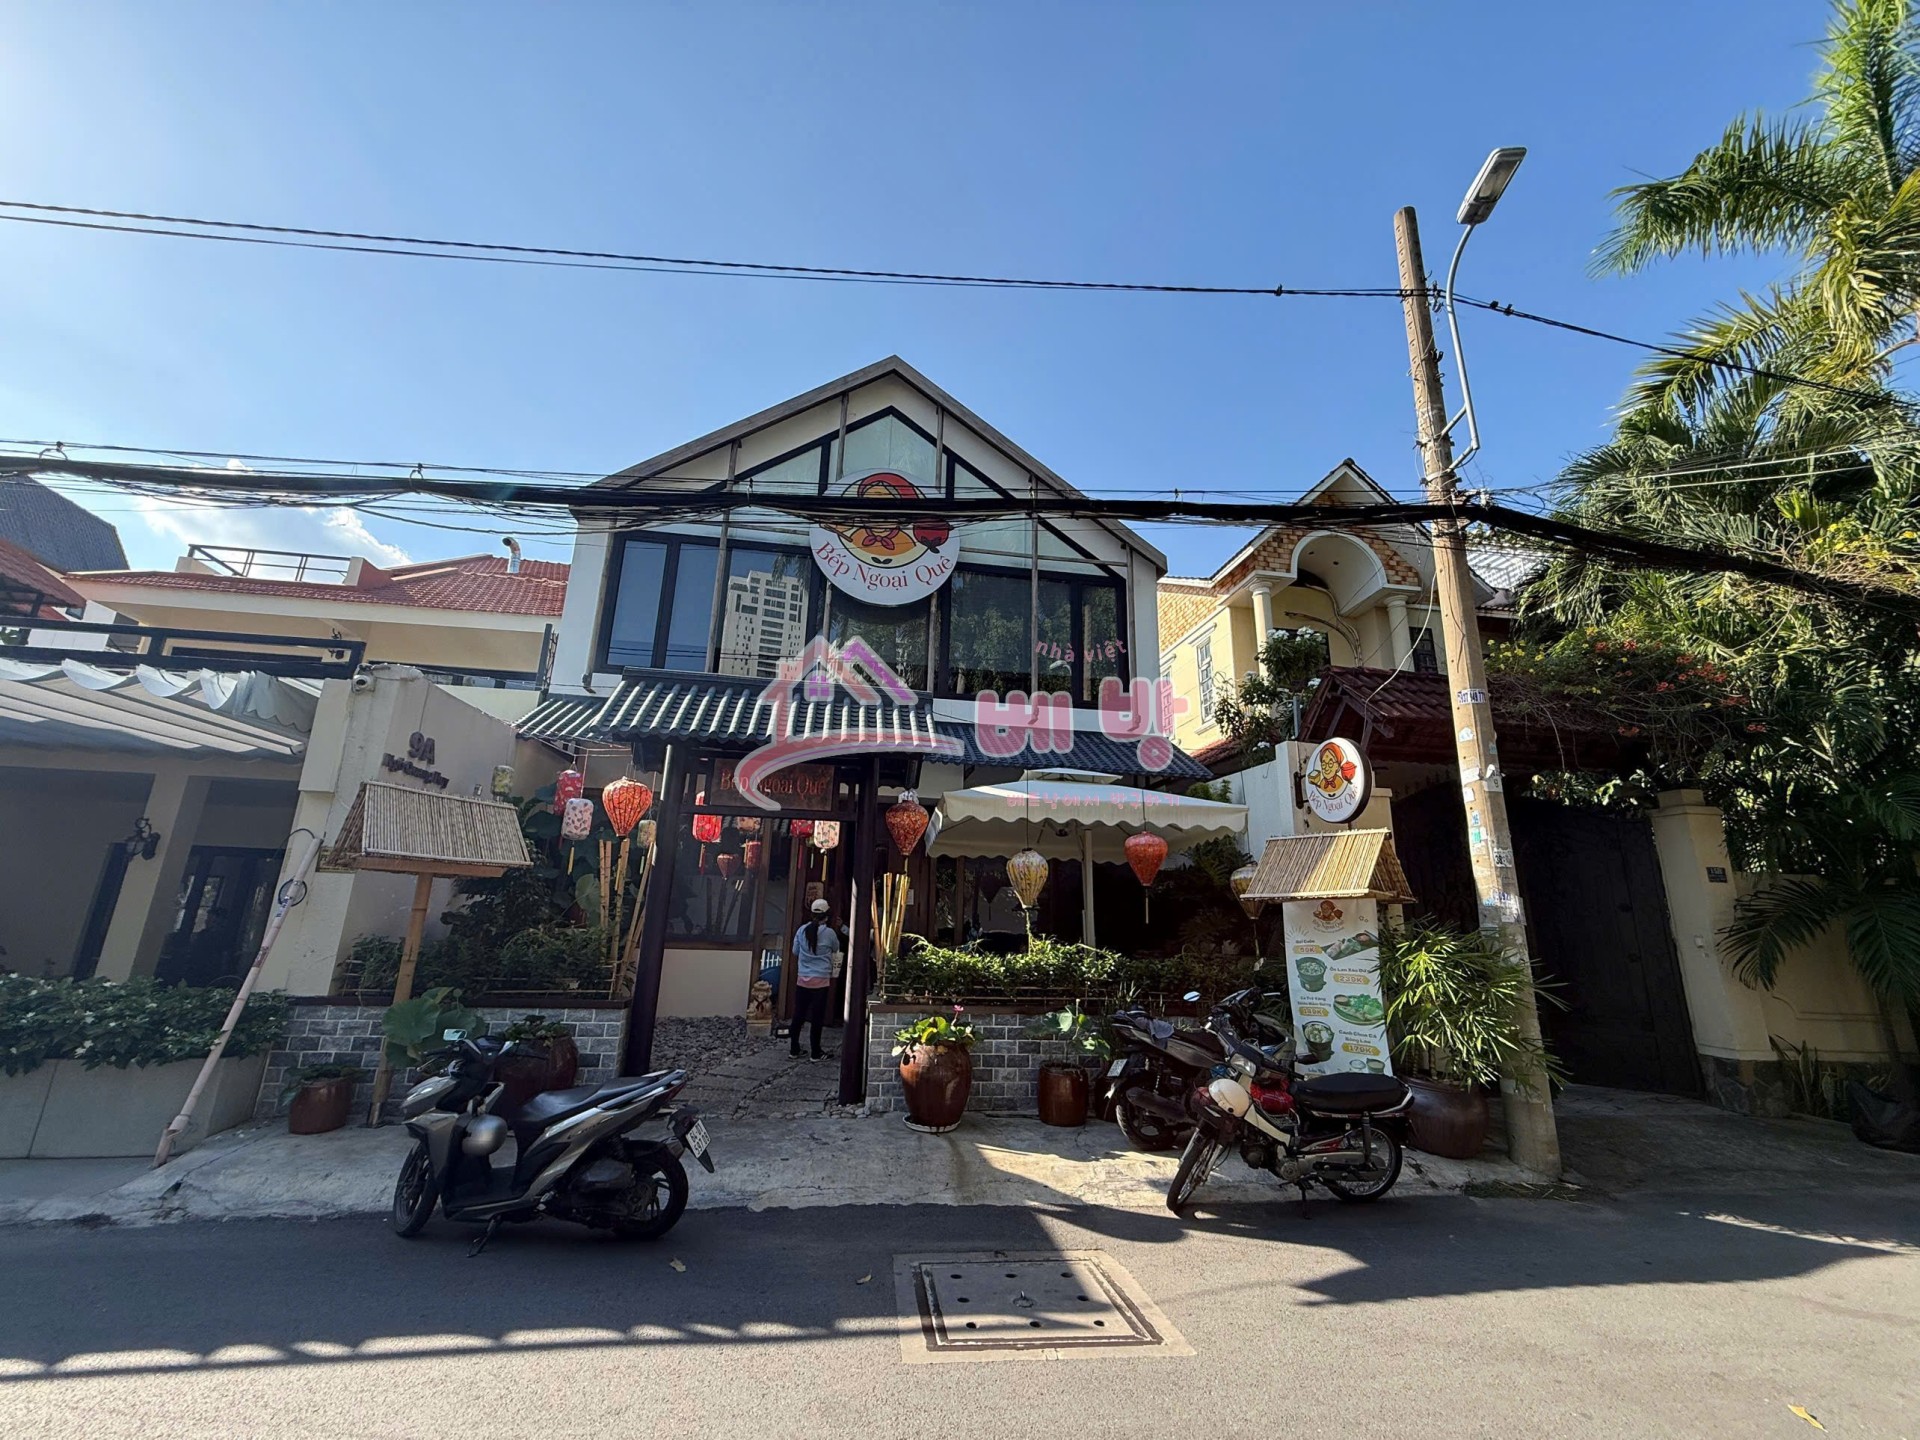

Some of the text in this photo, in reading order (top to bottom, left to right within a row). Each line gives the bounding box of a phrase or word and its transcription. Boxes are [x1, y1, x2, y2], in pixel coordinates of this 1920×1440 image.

[816, 541, 954, 592] Bếp Ngoại Quê
[408, 731, 436, 765] 9A
